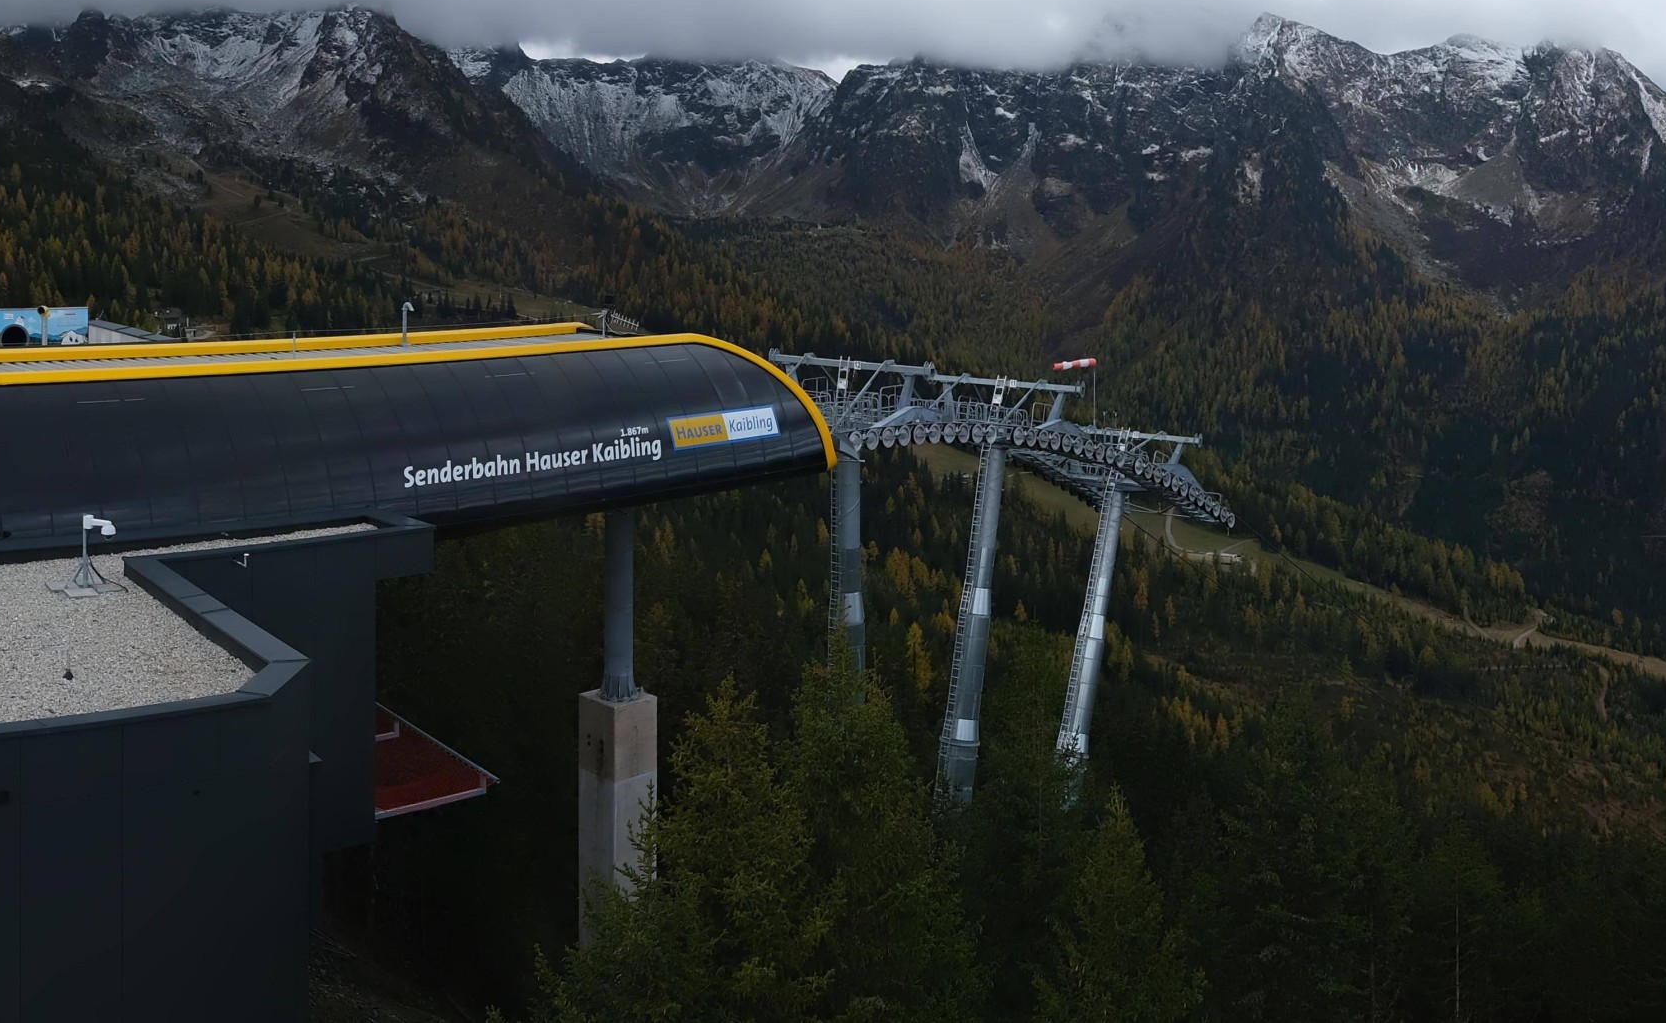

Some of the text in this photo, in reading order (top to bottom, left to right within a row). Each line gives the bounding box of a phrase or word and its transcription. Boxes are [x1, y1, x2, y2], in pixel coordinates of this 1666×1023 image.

[620, 426, 649, 437] 1.867m
[676, 415, 774, 440] HAUSER Kaibling
[403, 437, 662, 488] Senderbahn Hauser Kaibling
